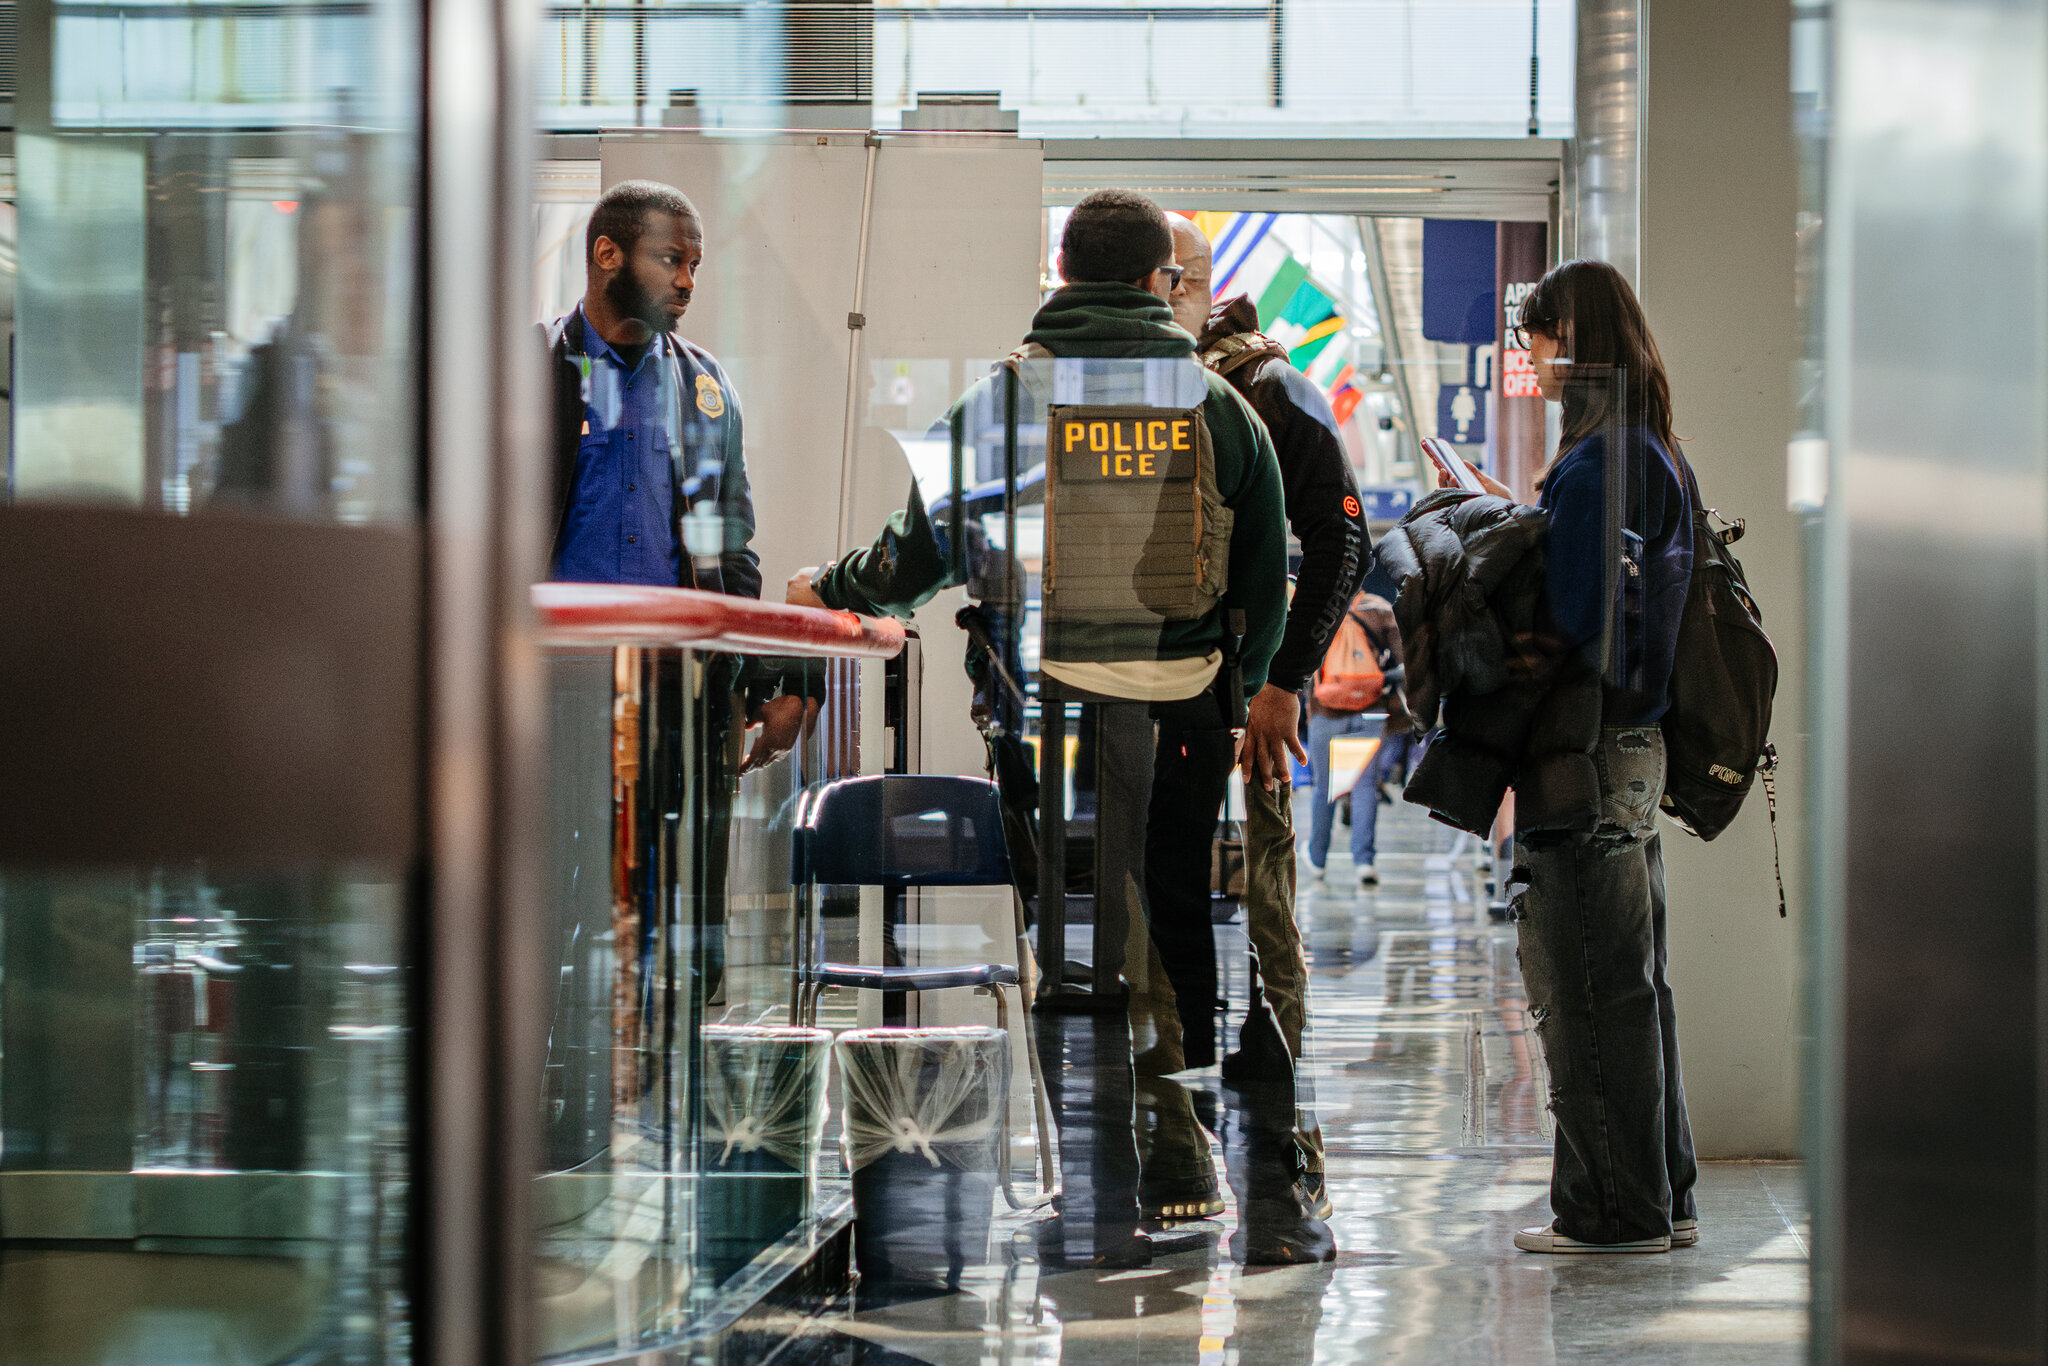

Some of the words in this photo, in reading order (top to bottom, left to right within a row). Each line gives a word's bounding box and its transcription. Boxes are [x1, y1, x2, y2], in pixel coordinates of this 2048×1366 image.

[1065, 420, 1191, 453] POLICE
[1101, 454, 1156, 477] ICE
[1310, 517, 1362, 646] SUPERDRY
